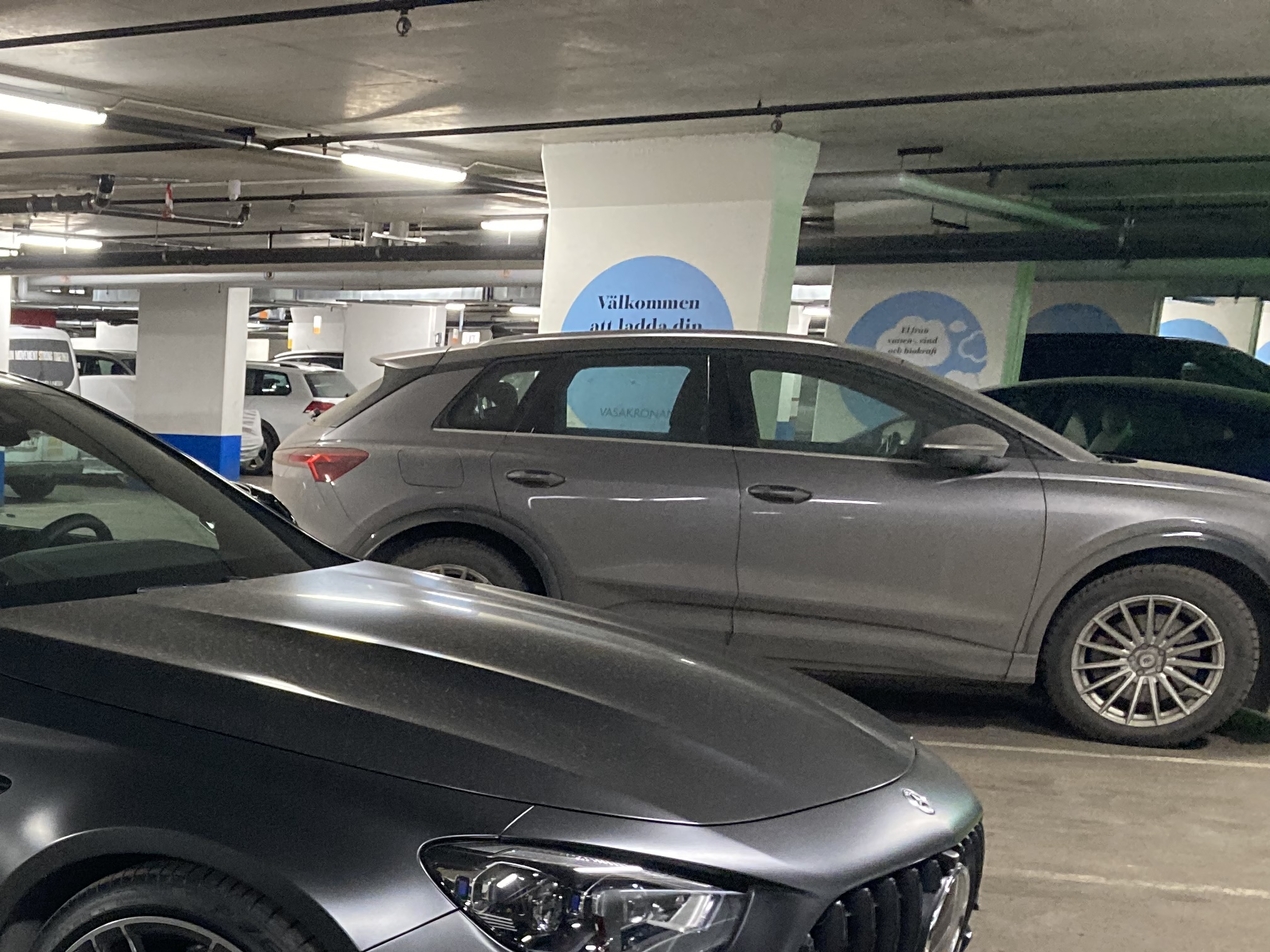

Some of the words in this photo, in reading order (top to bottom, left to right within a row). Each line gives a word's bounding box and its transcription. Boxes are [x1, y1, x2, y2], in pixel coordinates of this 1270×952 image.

[598, 294, 700, 310] Välkommen
[590, 320, 612, 331] att
[619, 318, 667, 330] ladda
[673, 318, 703, 330] din
